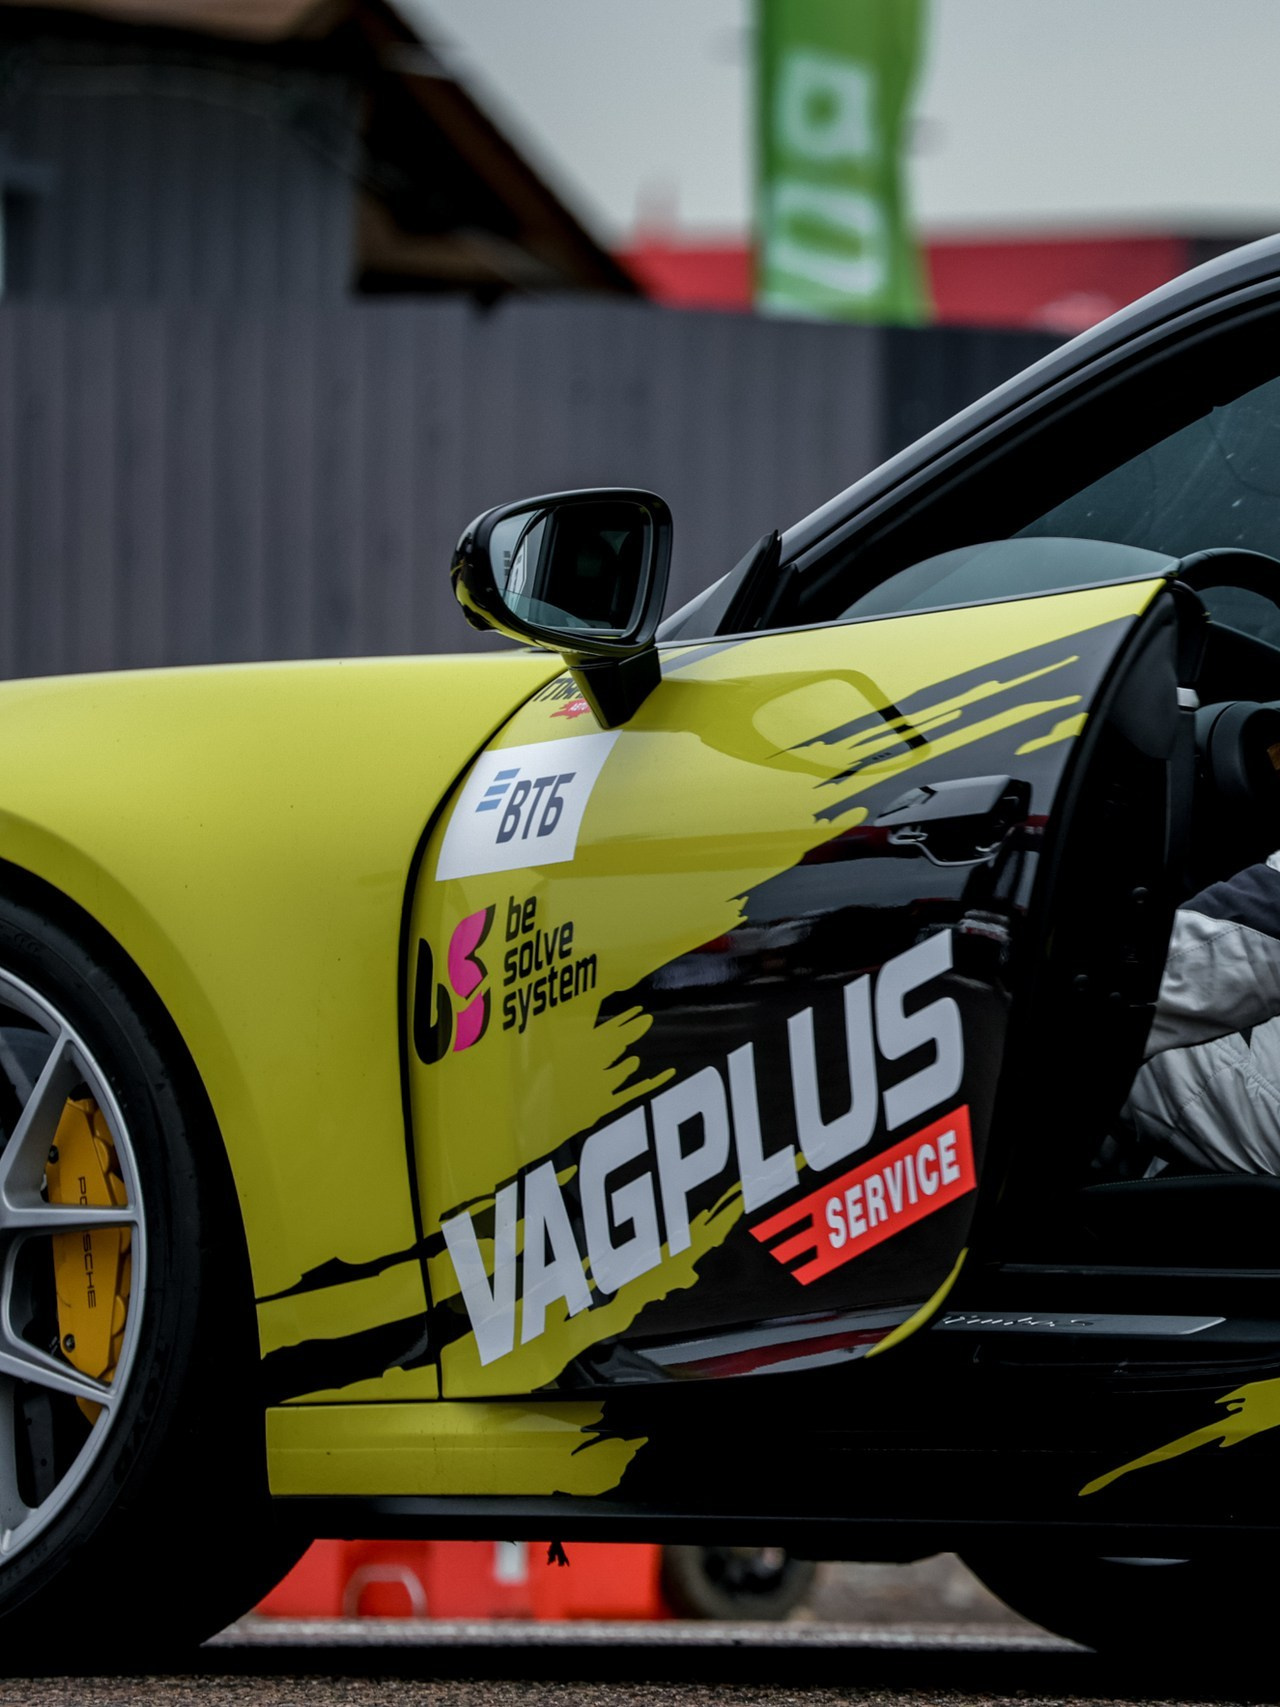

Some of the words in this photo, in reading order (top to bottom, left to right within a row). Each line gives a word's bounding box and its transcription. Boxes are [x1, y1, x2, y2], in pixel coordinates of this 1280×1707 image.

[495, 772, 577, 844] ВТБ
[503, 921, 575, 987] solve
[506, 895, 537, 942] be
[502, 953, 598, 1034] system
[441, 928, 965, 1367] VAGPLUS
[825, 1130, 961, 1249] SERVICE
[77, 1175, 97, 1310] POSCHE
